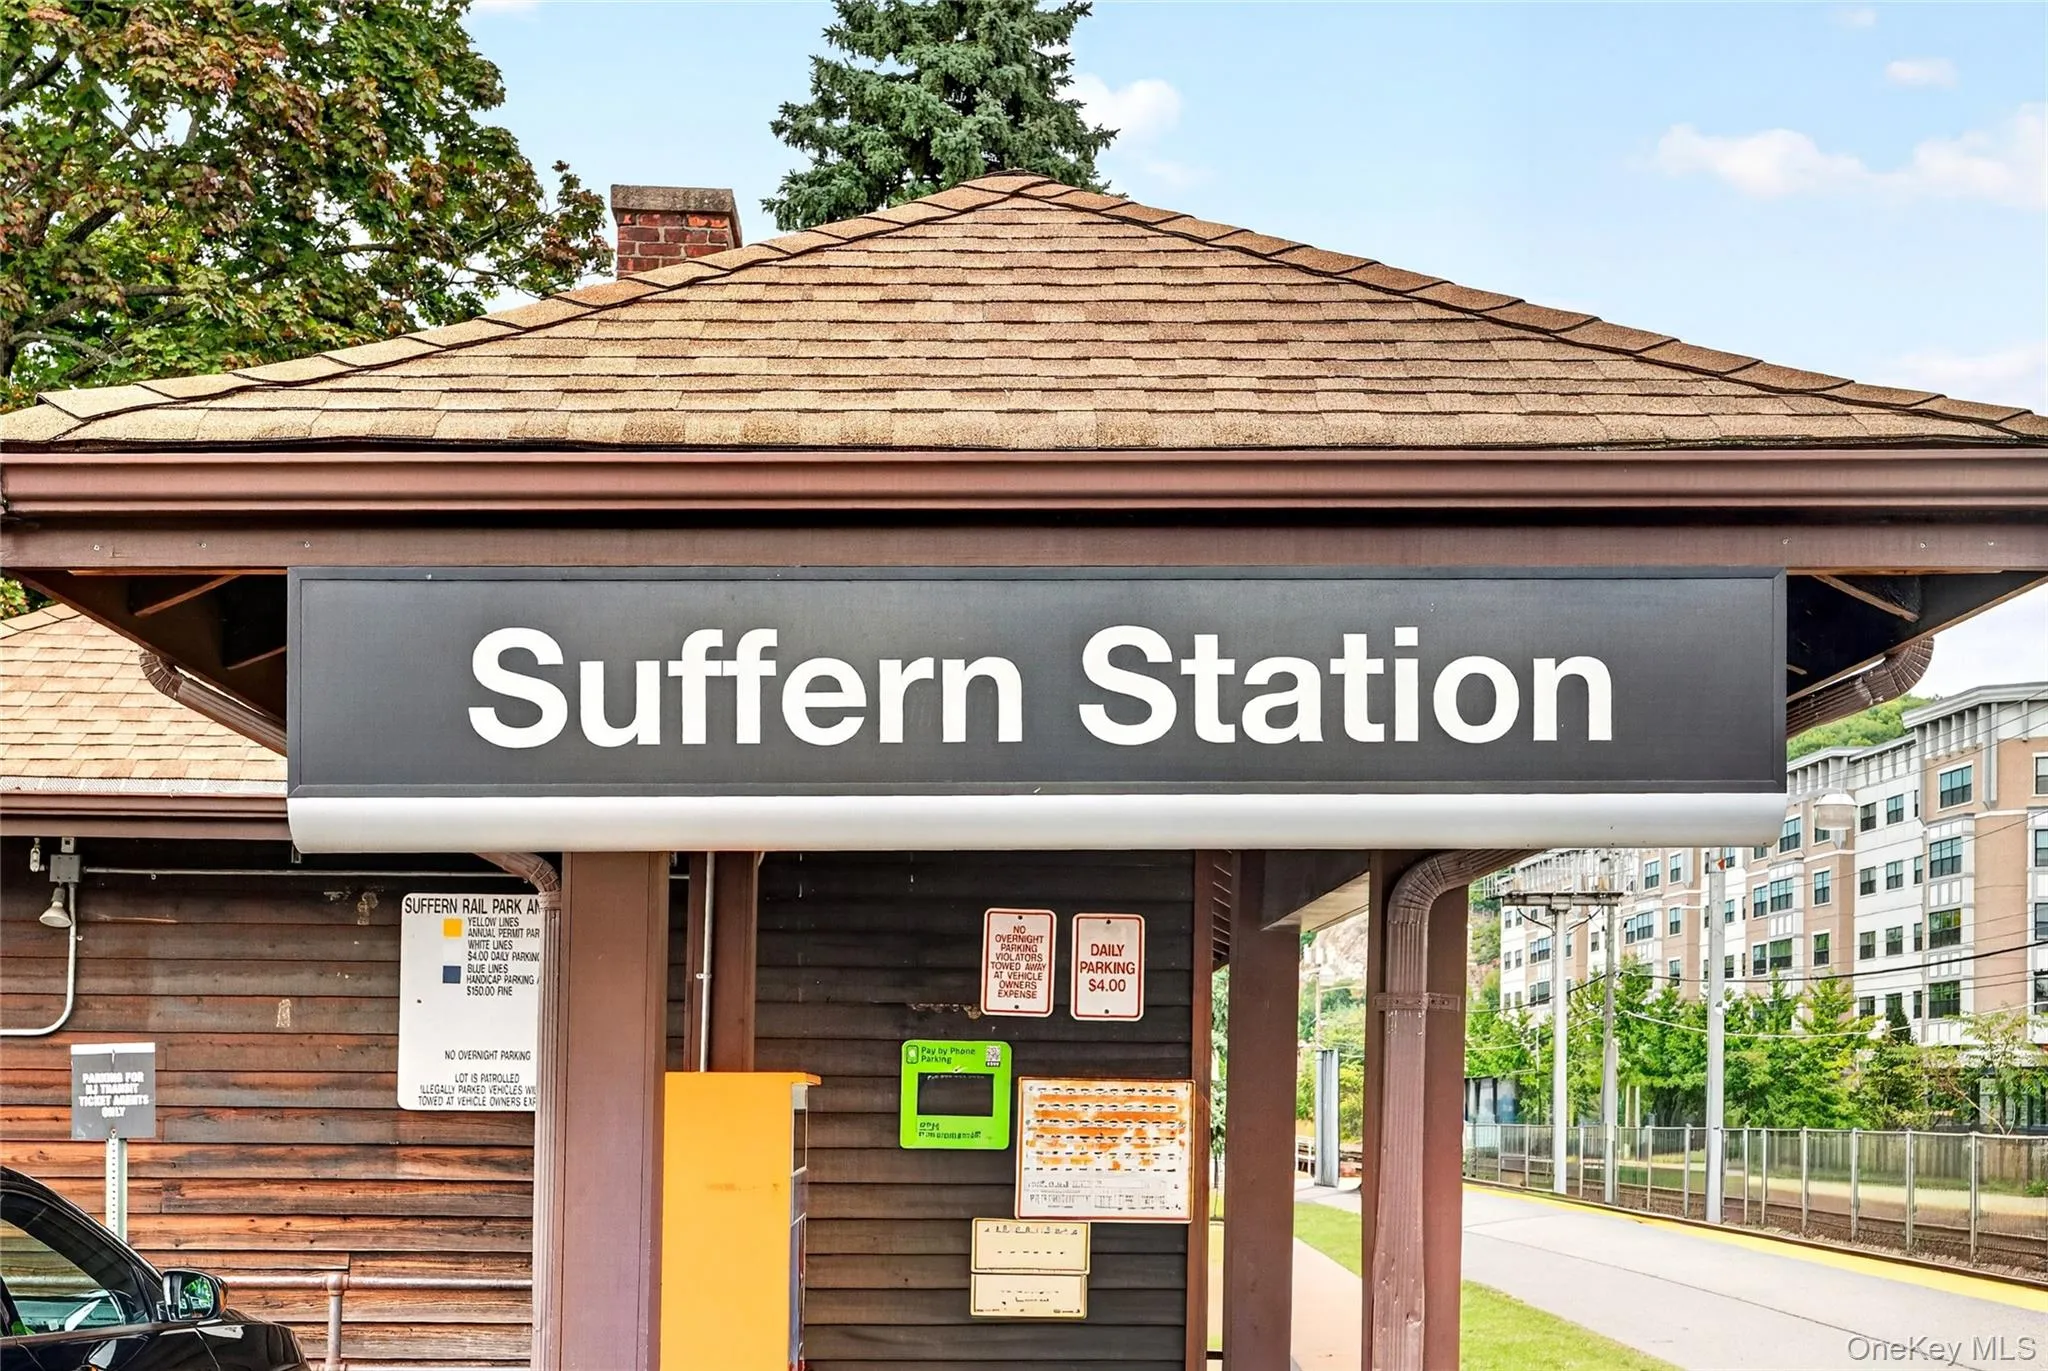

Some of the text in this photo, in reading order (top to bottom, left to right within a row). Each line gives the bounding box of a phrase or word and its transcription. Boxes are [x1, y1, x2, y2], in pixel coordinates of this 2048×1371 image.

[469, 626, 1613, 749] Suffern Station
[404, 897, 457, 914] SUFFERN
[462, 898, 487, 914] RAIL
[492, 898, 522, 914] PARK
[467, 917, 519, 927] YELLOW LINES
[467, 928, 495, 938] ANNUAL
[498, 928, 524, 938] PERMIT
[1013, 925, 1026, 935] NO
[995, 934, 1044, 944] OVERNIGHT
[467, 940, 513, 950] WHITE LINES
[1000, 943, 1038, 953] PARKING
[1090, 943, 1125, 957] DAILY
[467, 951, 489, 961] $4.00
[491, 952, 509, 961] DAILY
[995, 952, 1043, 962] VIOLATORS
[467, 964, 508, 974] BLUE LINES
[990, 961, 1046, 971] TOWED AWAY
[1079, 960, 1136, 975] PARKING
[466, 975, 501, 985] HANDICAP
[504, 975, 535, 985] PARKING
[993, 971, 1043, 981] AT VEHICLE
[998, 980, 1037, 990] OWNERS
[1088, 978, 1126, 992] $4.00
[466, 986, 513, 996] $150.00 FINE
[997, 989, 1037, 999] EXPENSE
[444, 1050, 531, 1061] NO OVERNIGHT PARKING
[921, 1046, 976, 1056] Pay by Phone
[921, 1055, 952, 1065] Parking
[455, 1073, 520, 1083] LOT IS PATROLLED
[420, 1084, 456, 1095] ILLEGALLY
[458, 1084, 486, 1095] PARKED
[489, 1085, 523, 1095] VEHICLES
[418, 1096, 444, 1106] TOWED
[446, 1096, 455, 1106] AT
[457, 1096, 487, 1106] VEHICLE
[489, 1096, 521, 1107] OWNERS
